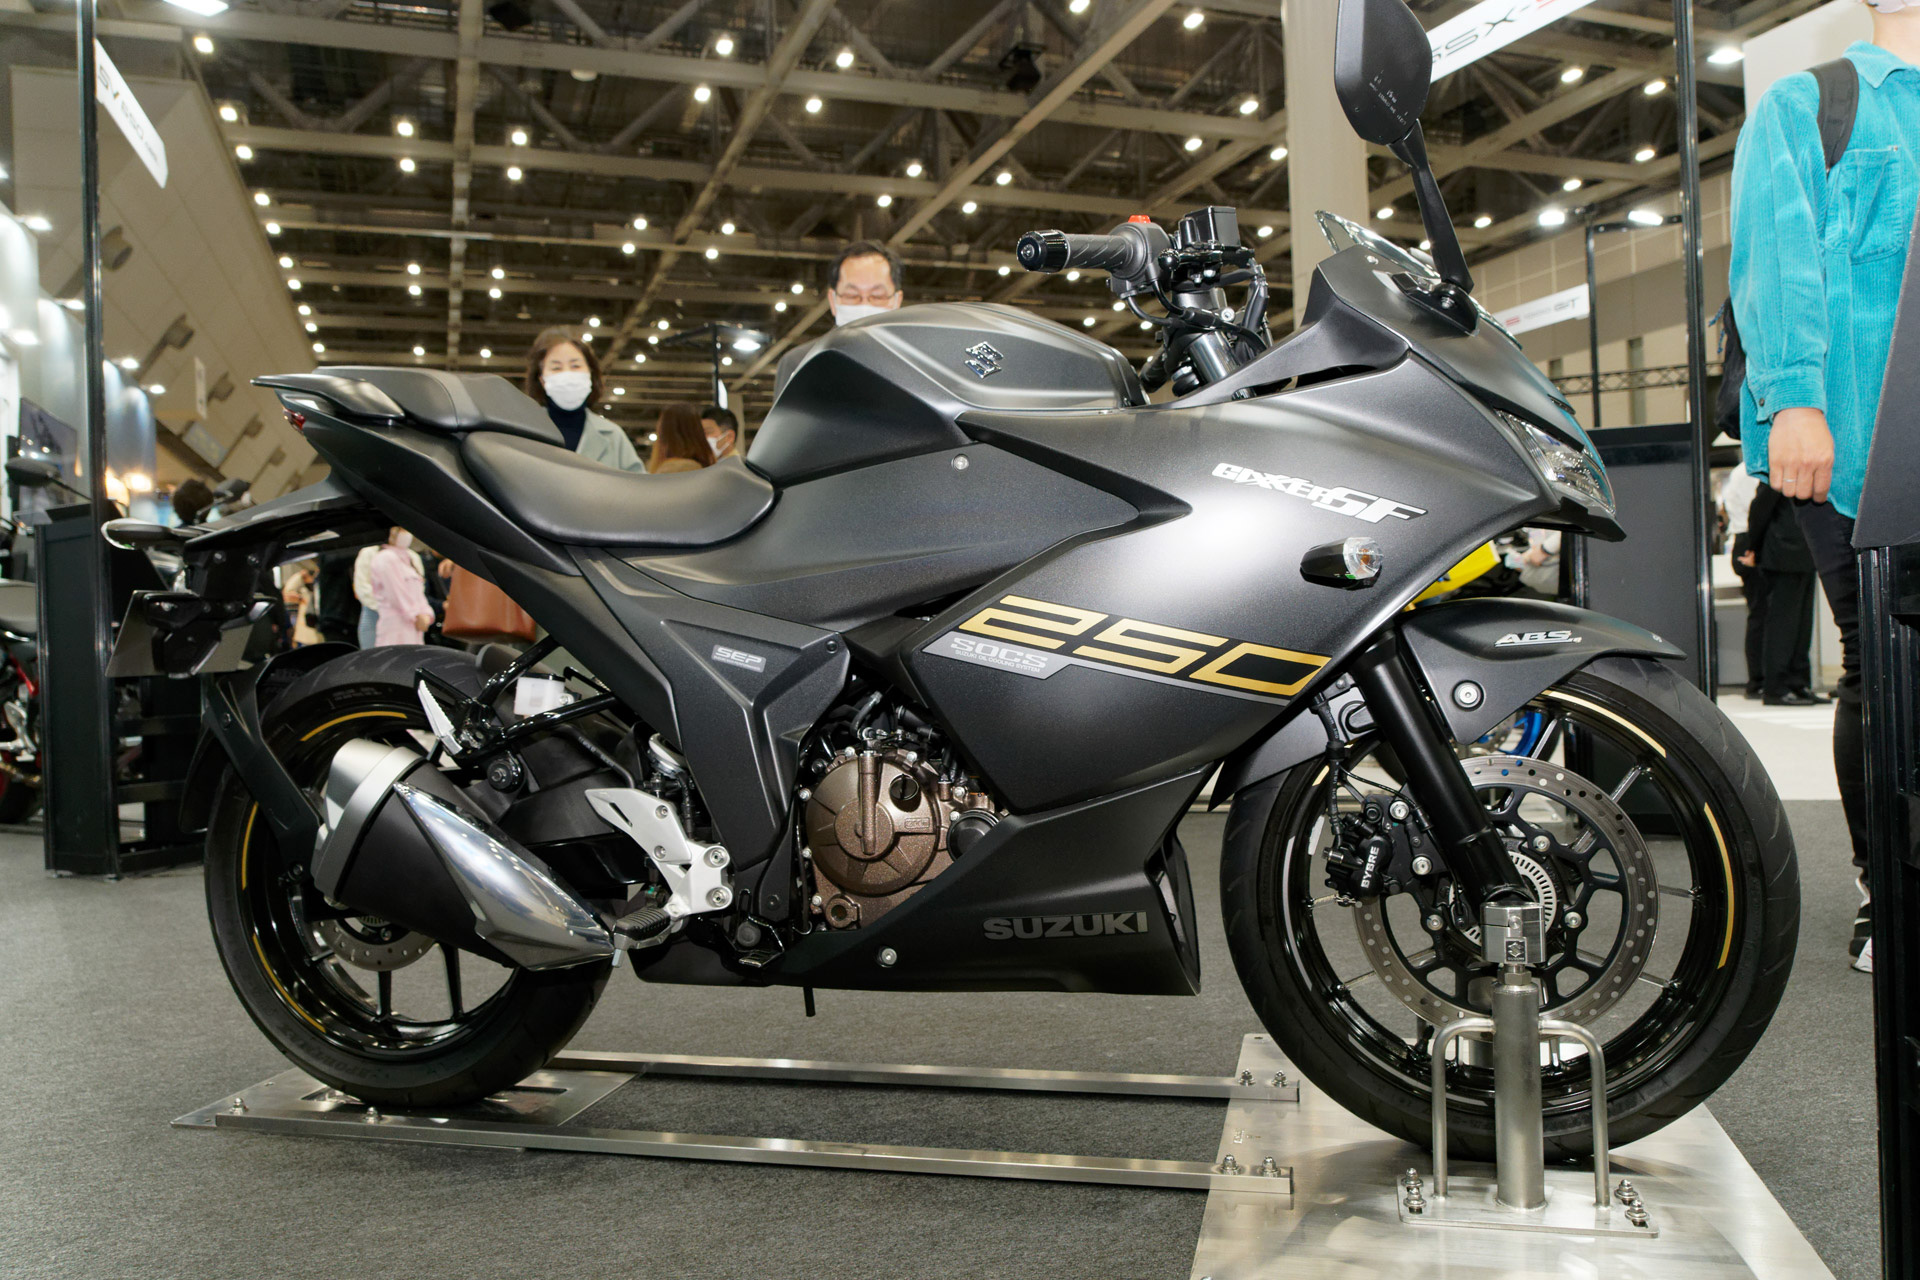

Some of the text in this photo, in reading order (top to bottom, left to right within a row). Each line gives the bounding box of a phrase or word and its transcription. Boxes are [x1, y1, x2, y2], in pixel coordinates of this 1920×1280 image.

[1310, 486, 1428, 523] SF
[950, 637, 1048, 669] SOCS
[958, 594, 1333, 697] 250
[1495, 631, 1572, 647] ABS
[715, 647, 762, 664] SEP
[955, 649, 978, 659] SUZUKI
[988, 657, 1015, 668] COOLING
[1015, 663, 1041, 673] SYSTEM
[1360, 846, 1380, 889] BYBRE
[982, 911, 1149, 941] SUZUKI
